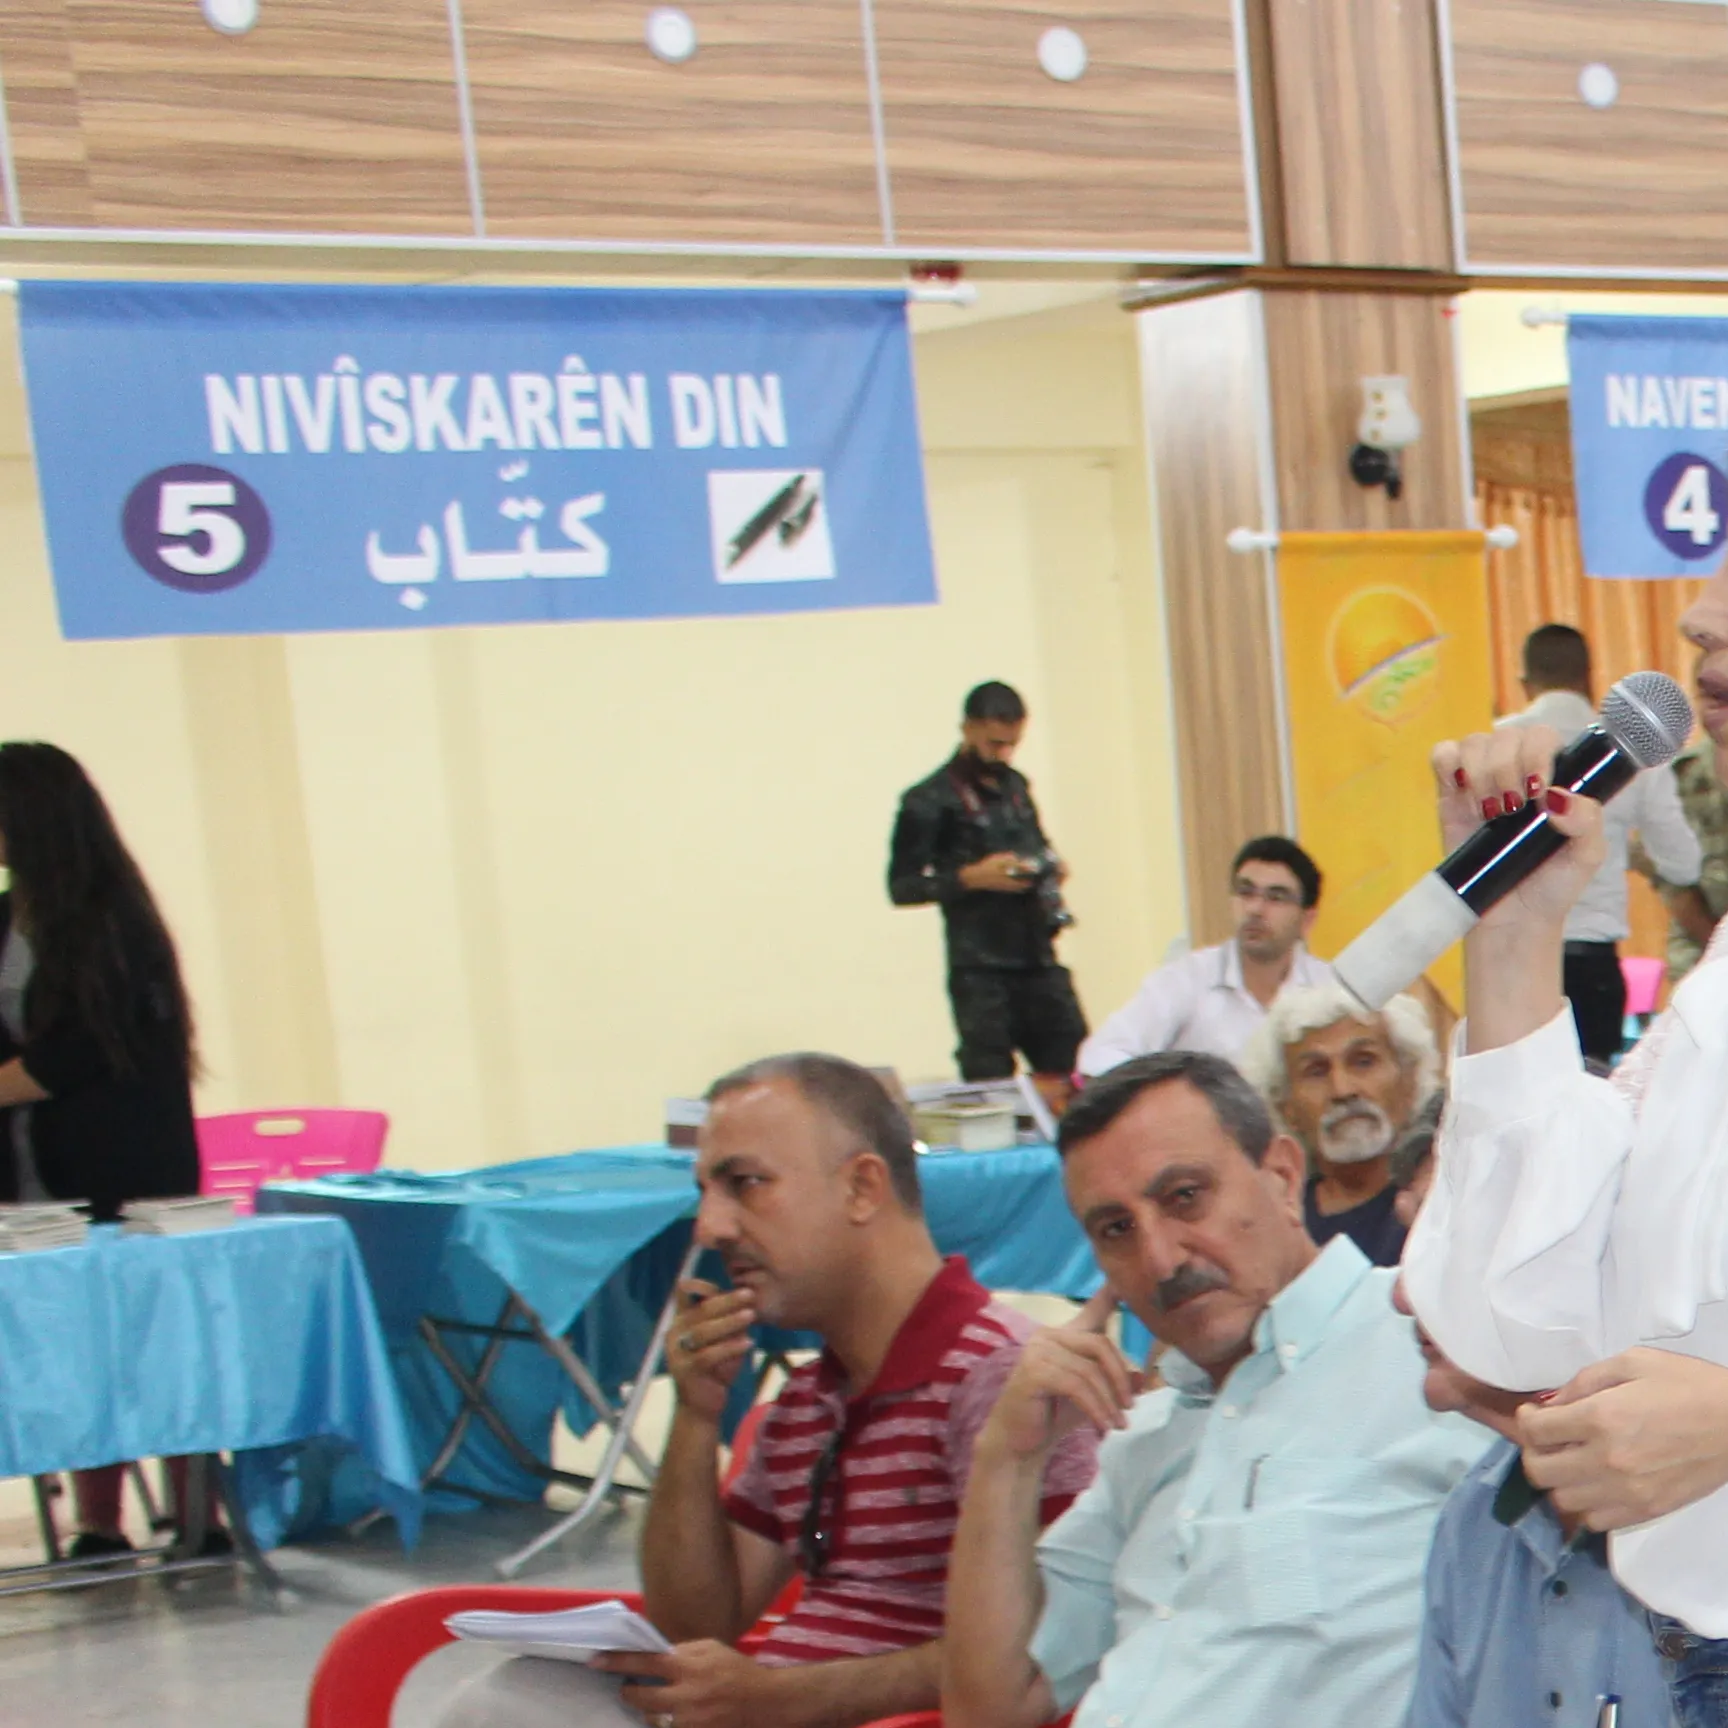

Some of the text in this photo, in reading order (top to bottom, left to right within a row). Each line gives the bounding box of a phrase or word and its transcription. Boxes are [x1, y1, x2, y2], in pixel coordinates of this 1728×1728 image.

[207, 355, 786, 453] NIVÎSKARÊN DIN
[156, 482, 247, 574] 5
[1663, 465, 1719, 546] 4
